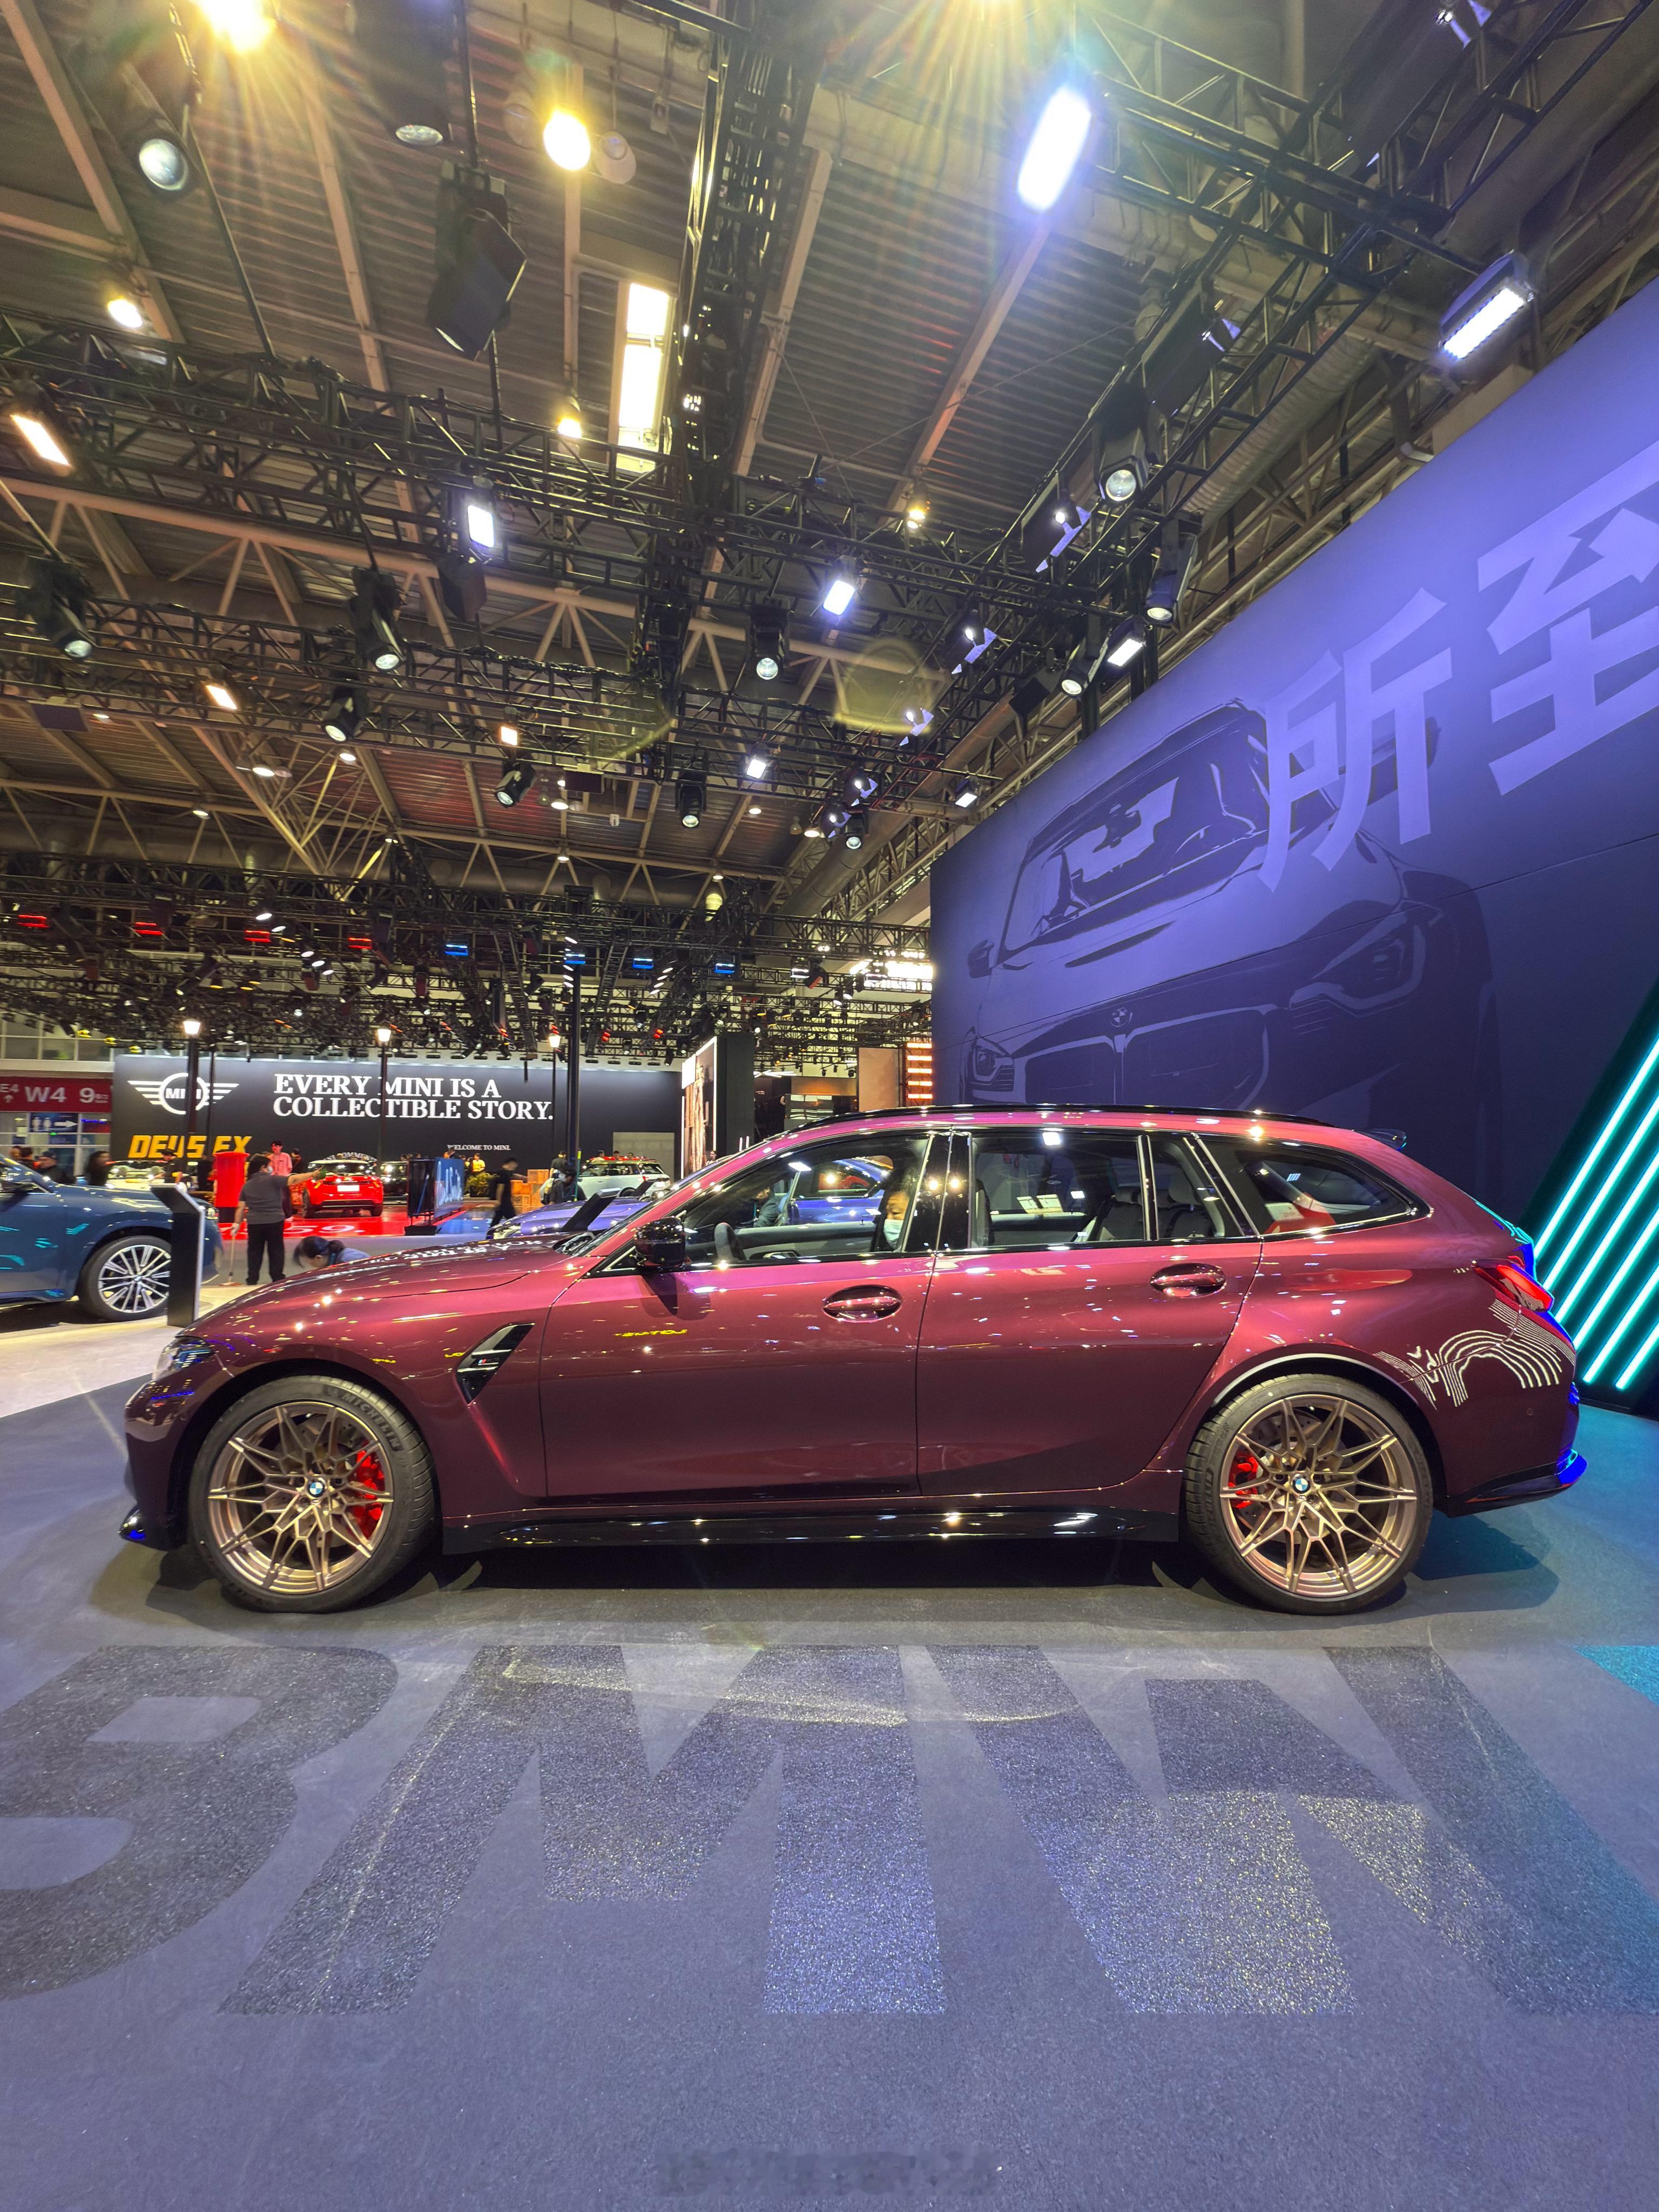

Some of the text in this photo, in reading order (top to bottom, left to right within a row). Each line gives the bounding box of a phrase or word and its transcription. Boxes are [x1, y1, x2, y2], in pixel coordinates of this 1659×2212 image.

[24, 1086, 67, 1103] W4
[79, 1087, 95, 1103] 9
[165, 1088, 201, 1100] MII
[273, 1074, 502, 1098] EVERY MINI IS A
[273, 1096, 554, 1120] COLLECTIBLE STORY.
[127, 1135, 207, 1158] DEUS
[341, 1392, 400, 1448] MICHELIN
[0, 1644, 1659, 2015] BMW
